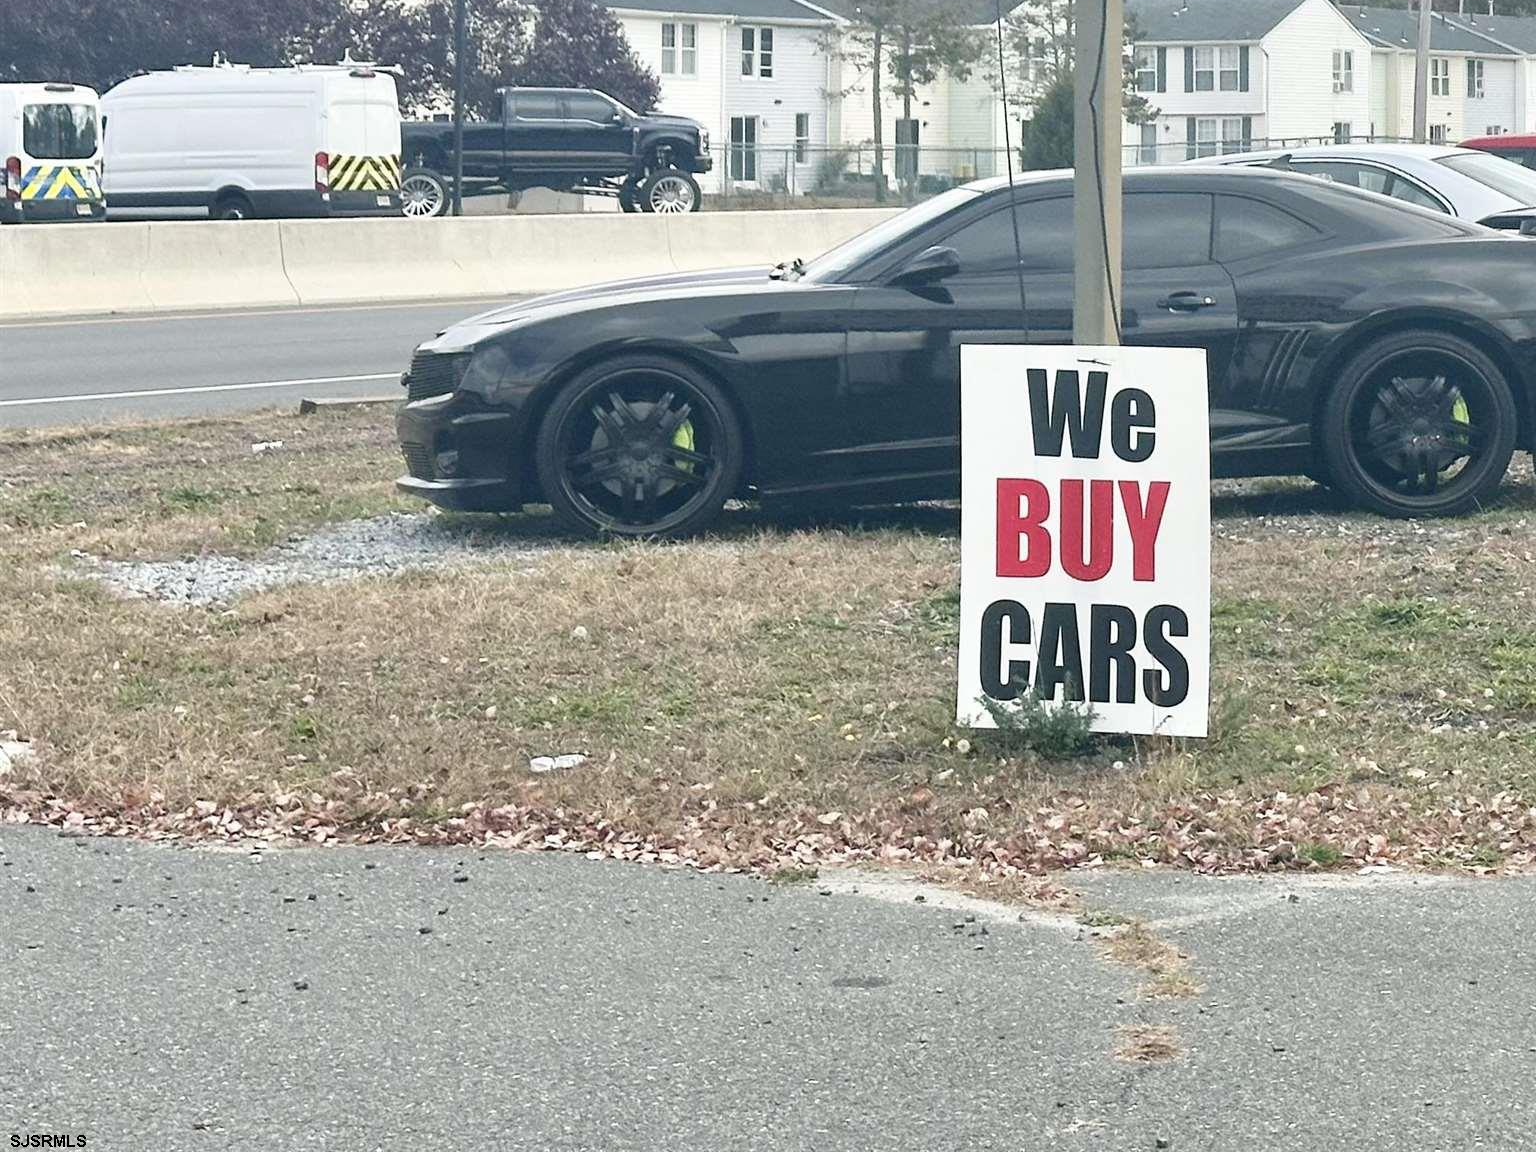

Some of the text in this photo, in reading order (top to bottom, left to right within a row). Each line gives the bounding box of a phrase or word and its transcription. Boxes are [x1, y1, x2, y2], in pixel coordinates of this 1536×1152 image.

[1026, 368, 1156, 463] We
[996, 477, 1172, 582] BUY
[979, 599, 1190, 708] CARS
